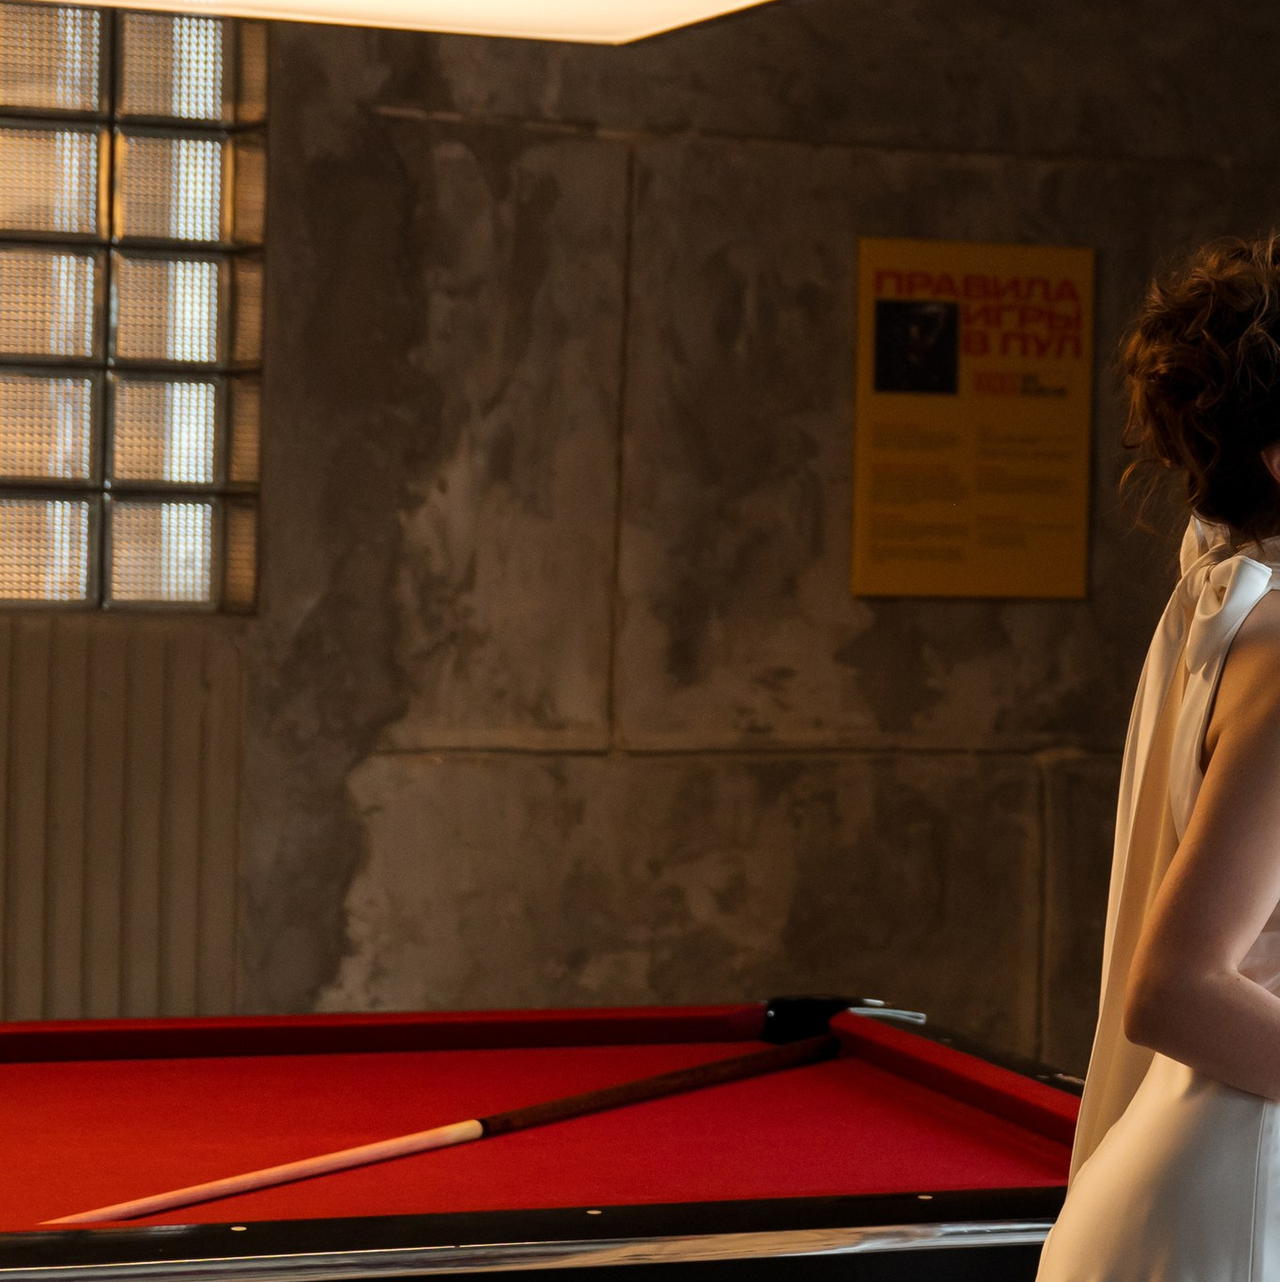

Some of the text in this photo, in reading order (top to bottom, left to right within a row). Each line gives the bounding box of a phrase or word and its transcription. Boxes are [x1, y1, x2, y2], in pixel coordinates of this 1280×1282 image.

[874, 270, 1080, 302] ПРАВИЛА
[961, 328, 1083, 360] В ПУЛ
